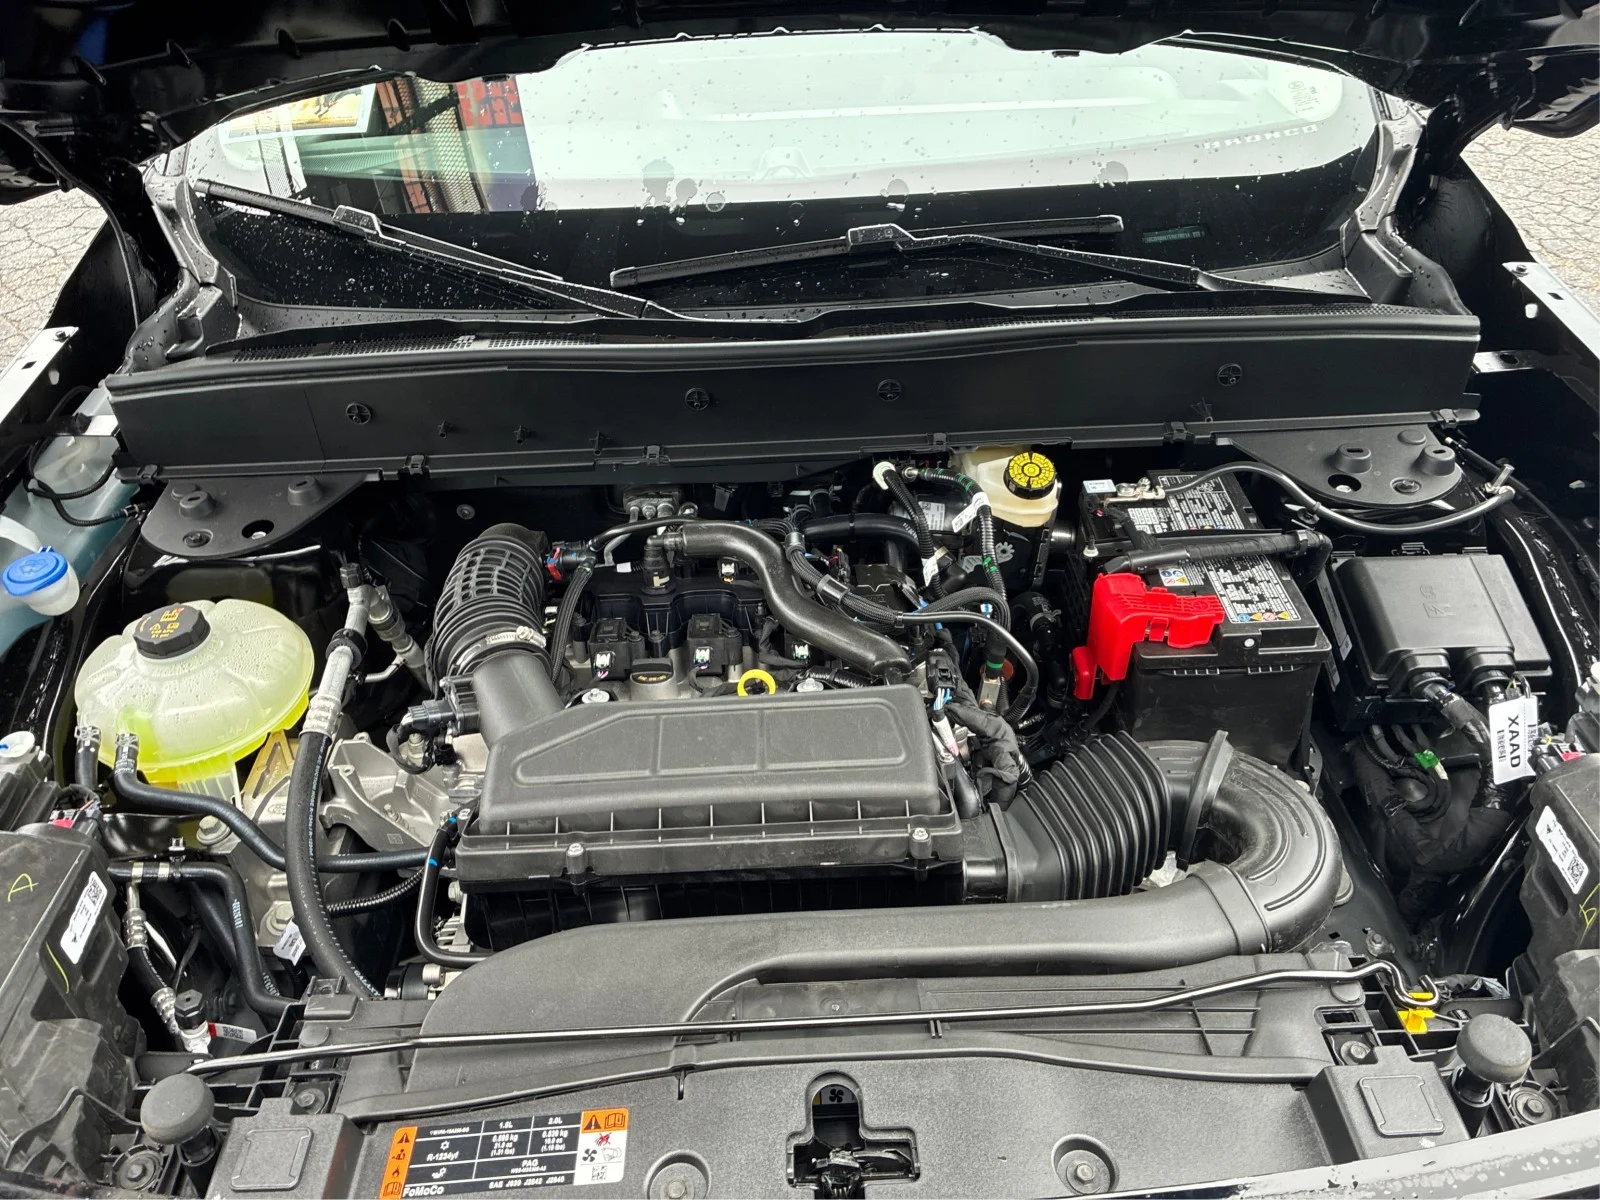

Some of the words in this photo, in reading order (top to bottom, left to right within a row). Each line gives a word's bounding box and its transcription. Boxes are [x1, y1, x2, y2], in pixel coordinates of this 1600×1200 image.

[1202, 124, 1318, 150] BRONCO
[1508, 714, 1522, 768] XAAD
[312, 765, 321, 790] SUCTION
[7, 873, 40, 903] A
[547, 1116, 563, 1124] 2.0L
[509, 1132, 518, 1142] kg
[559, 1128, 568, 1138] kg
[425, 1150, 459, 1162] R-1234yf
[521, 1158, 538, 1167] PAG
[402, 1185, 444, 1198] FoMoCo
[488, 1180, 503, 1188] SAE
